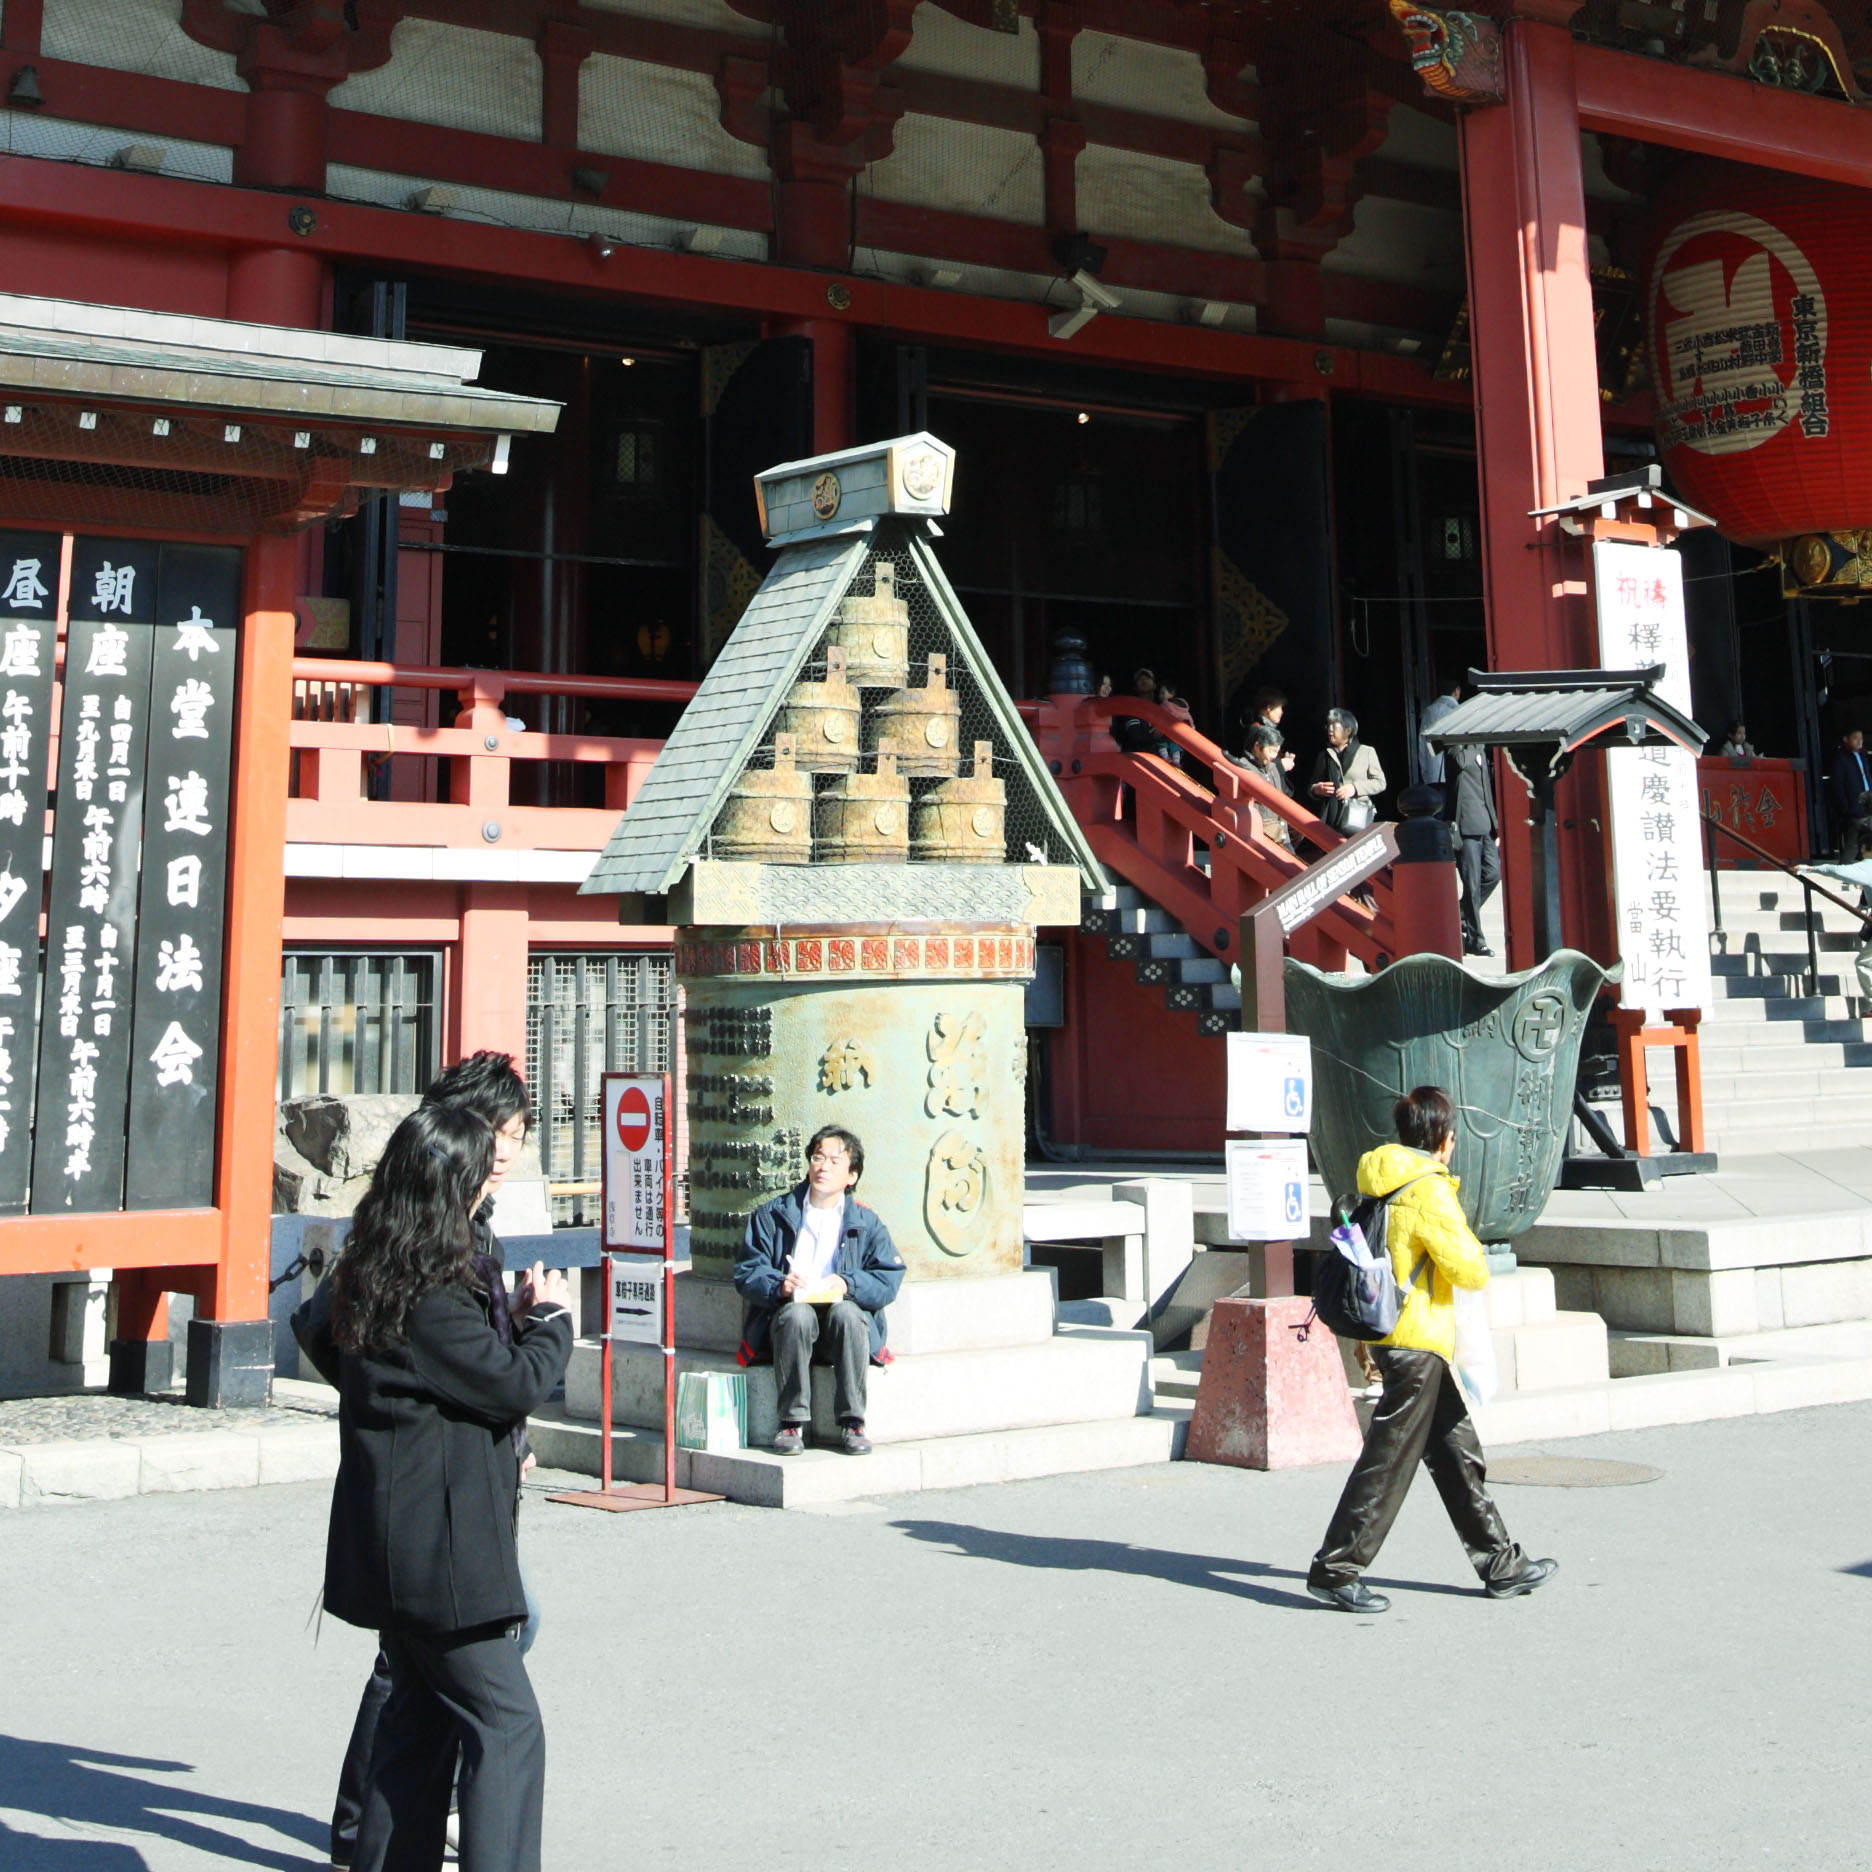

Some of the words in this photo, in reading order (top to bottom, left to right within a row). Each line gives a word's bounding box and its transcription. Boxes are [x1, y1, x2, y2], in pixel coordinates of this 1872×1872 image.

[1792, 293, 1828, 438] 東京新橋組合
[85, 560, 136, 676] 朝座
[107, 694, 133, 802] 自四月一日
[79, 804, 114, 914] 午前六時
[149, 605, 220, 1087] 本堂連日法会
[91, 923, 119, 1037] 自十月一日
[1628, 900, 1647, 985] 當山
[63, 1038, 100, 1181] 午前六時半
[633, 1159, 643, 1236] 出来ません
[644, 1159, 654, 1237] 車両は通行
